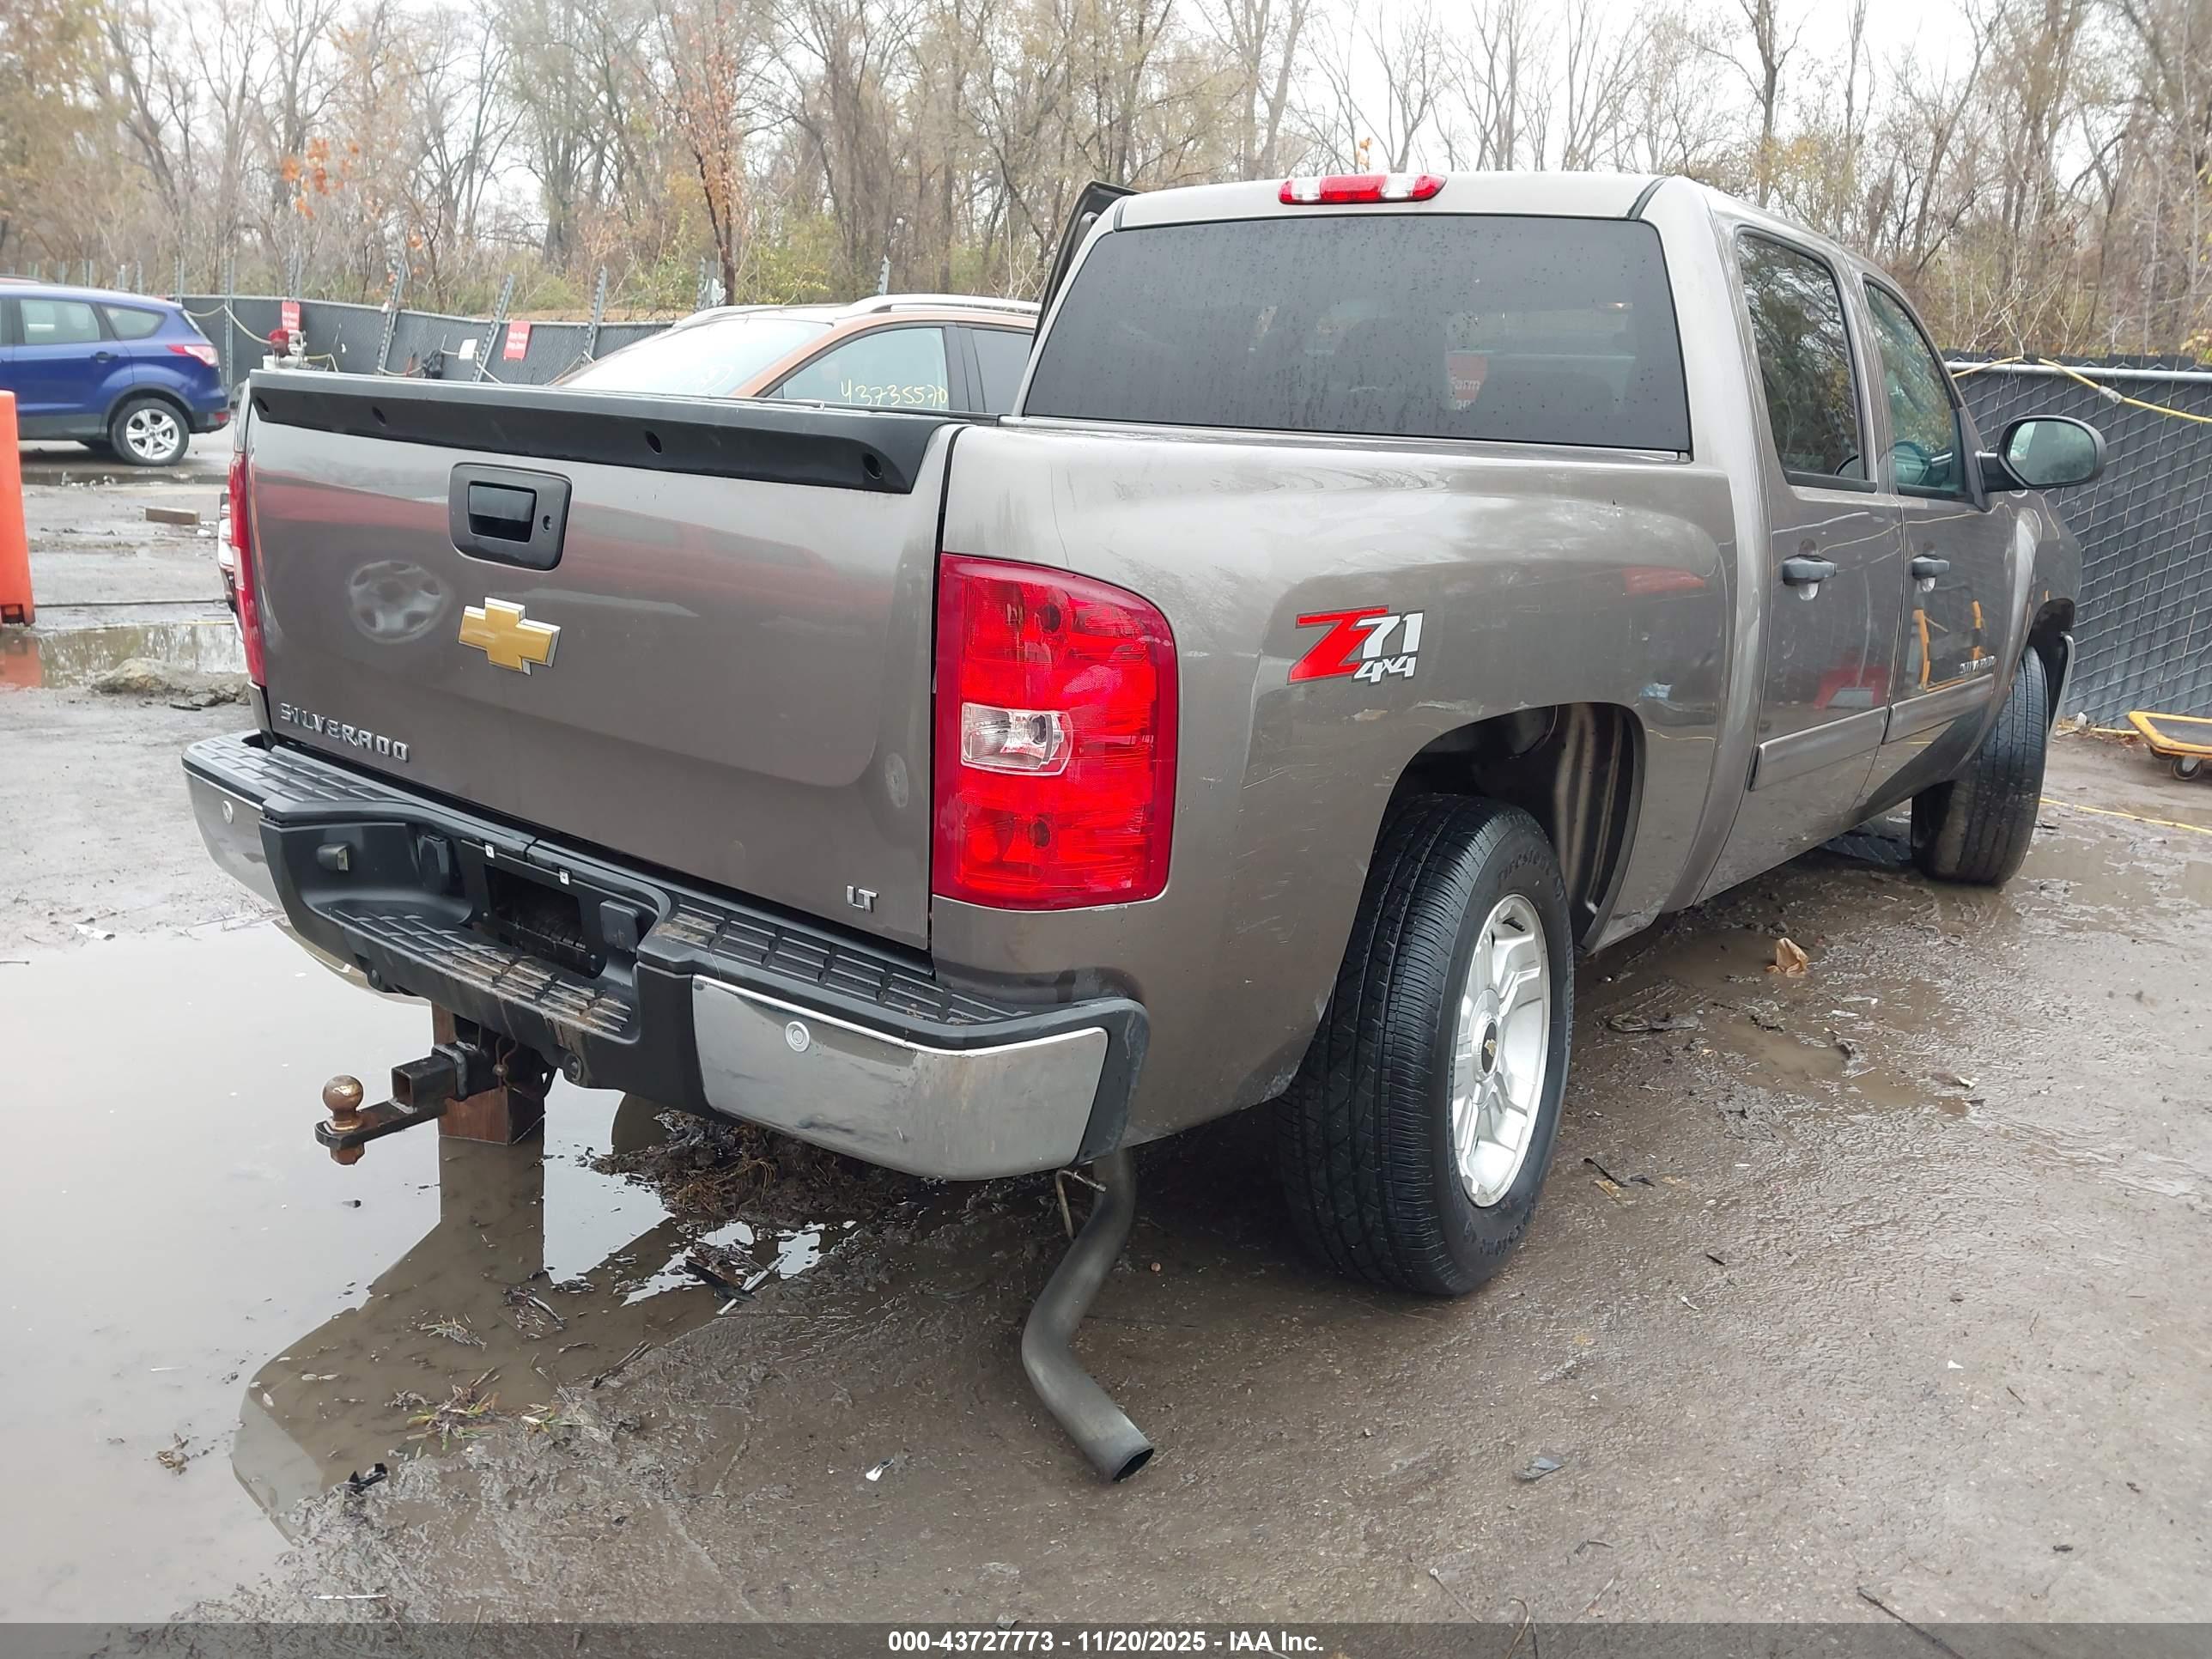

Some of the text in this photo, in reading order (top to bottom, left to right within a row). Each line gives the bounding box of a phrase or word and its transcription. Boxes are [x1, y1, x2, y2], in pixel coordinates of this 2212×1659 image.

[1287, 605, 1425, 685] Z71
[280, 702, 408, 762] SILVERADO
[847, 885, 878, 911] LT
